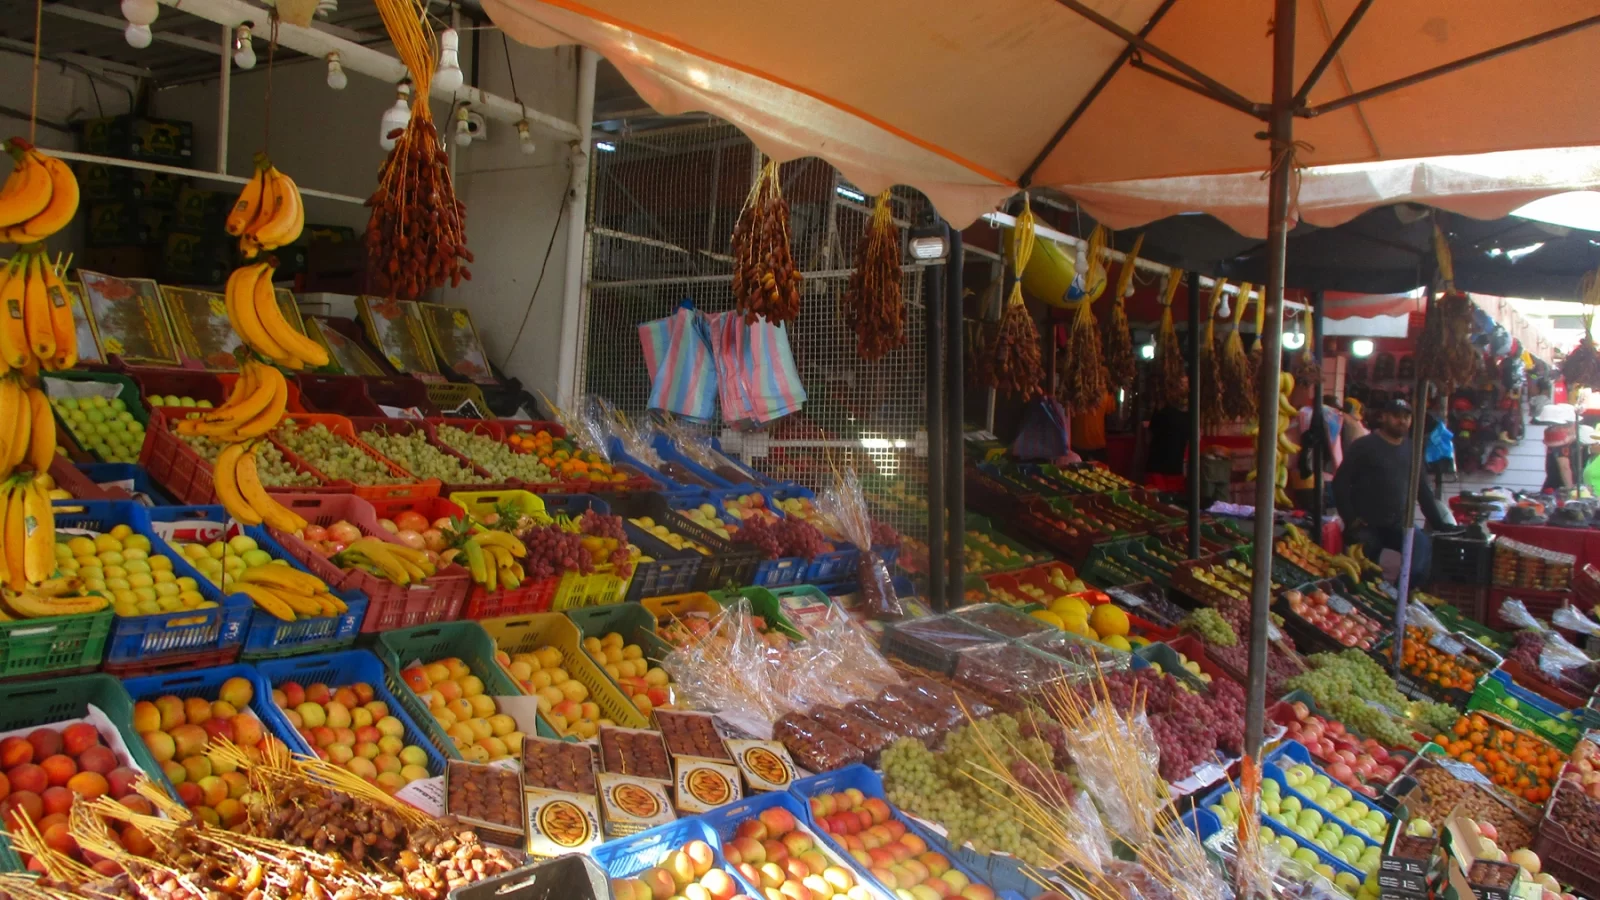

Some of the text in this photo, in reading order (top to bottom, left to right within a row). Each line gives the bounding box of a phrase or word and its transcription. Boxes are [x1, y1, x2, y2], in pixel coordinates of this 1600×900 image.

[1406, 863, 1410, 871] 1
[1403, 880, 1407, 888] 1
[1486, 892, 1490, 900] 1
